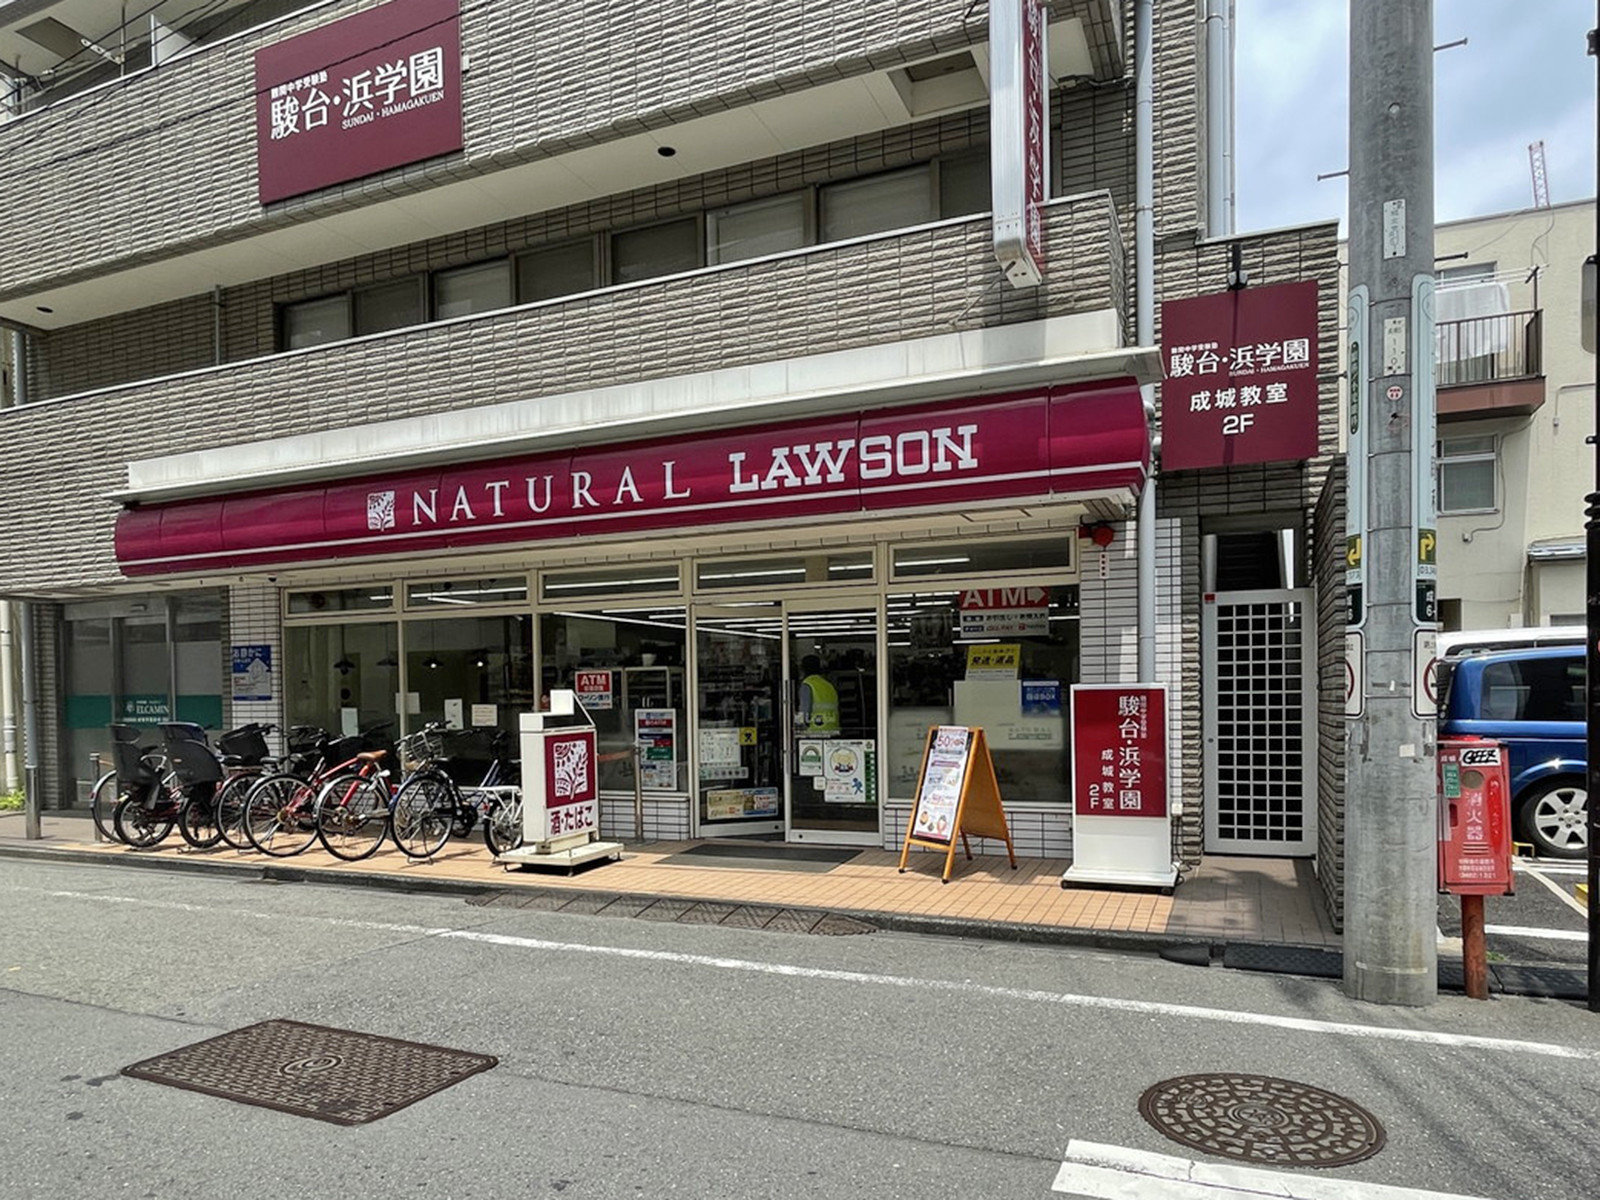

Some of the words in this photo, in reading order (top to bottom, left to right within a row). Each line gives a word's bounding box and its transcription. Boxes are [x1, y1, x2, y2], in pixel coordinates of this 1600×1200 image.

[270, 47, 444, 139] 駿台・浜学園
[342, 112, 374, 130] SUNDAI
[1169, 338, 1309, 378] 駿台・浜学園
[1189, 383, 1288, 412] 成城教室
[1222, 413, 1254, 435] 2F
[411, 461, 690, 525] NATURAL
[729, 424, 979, 493] LAWSON
[580, 674, 606, 686] ATM
[1118, 695, 1141, 810] 駿台・浜学園
[1089, 783, 1100, 809] 2F
[1101, 748, 1114, 810] 成城教室
[550, 805, 593, 835] 酒・たばこ
[1465, 791, 1483, 841] 消火器
